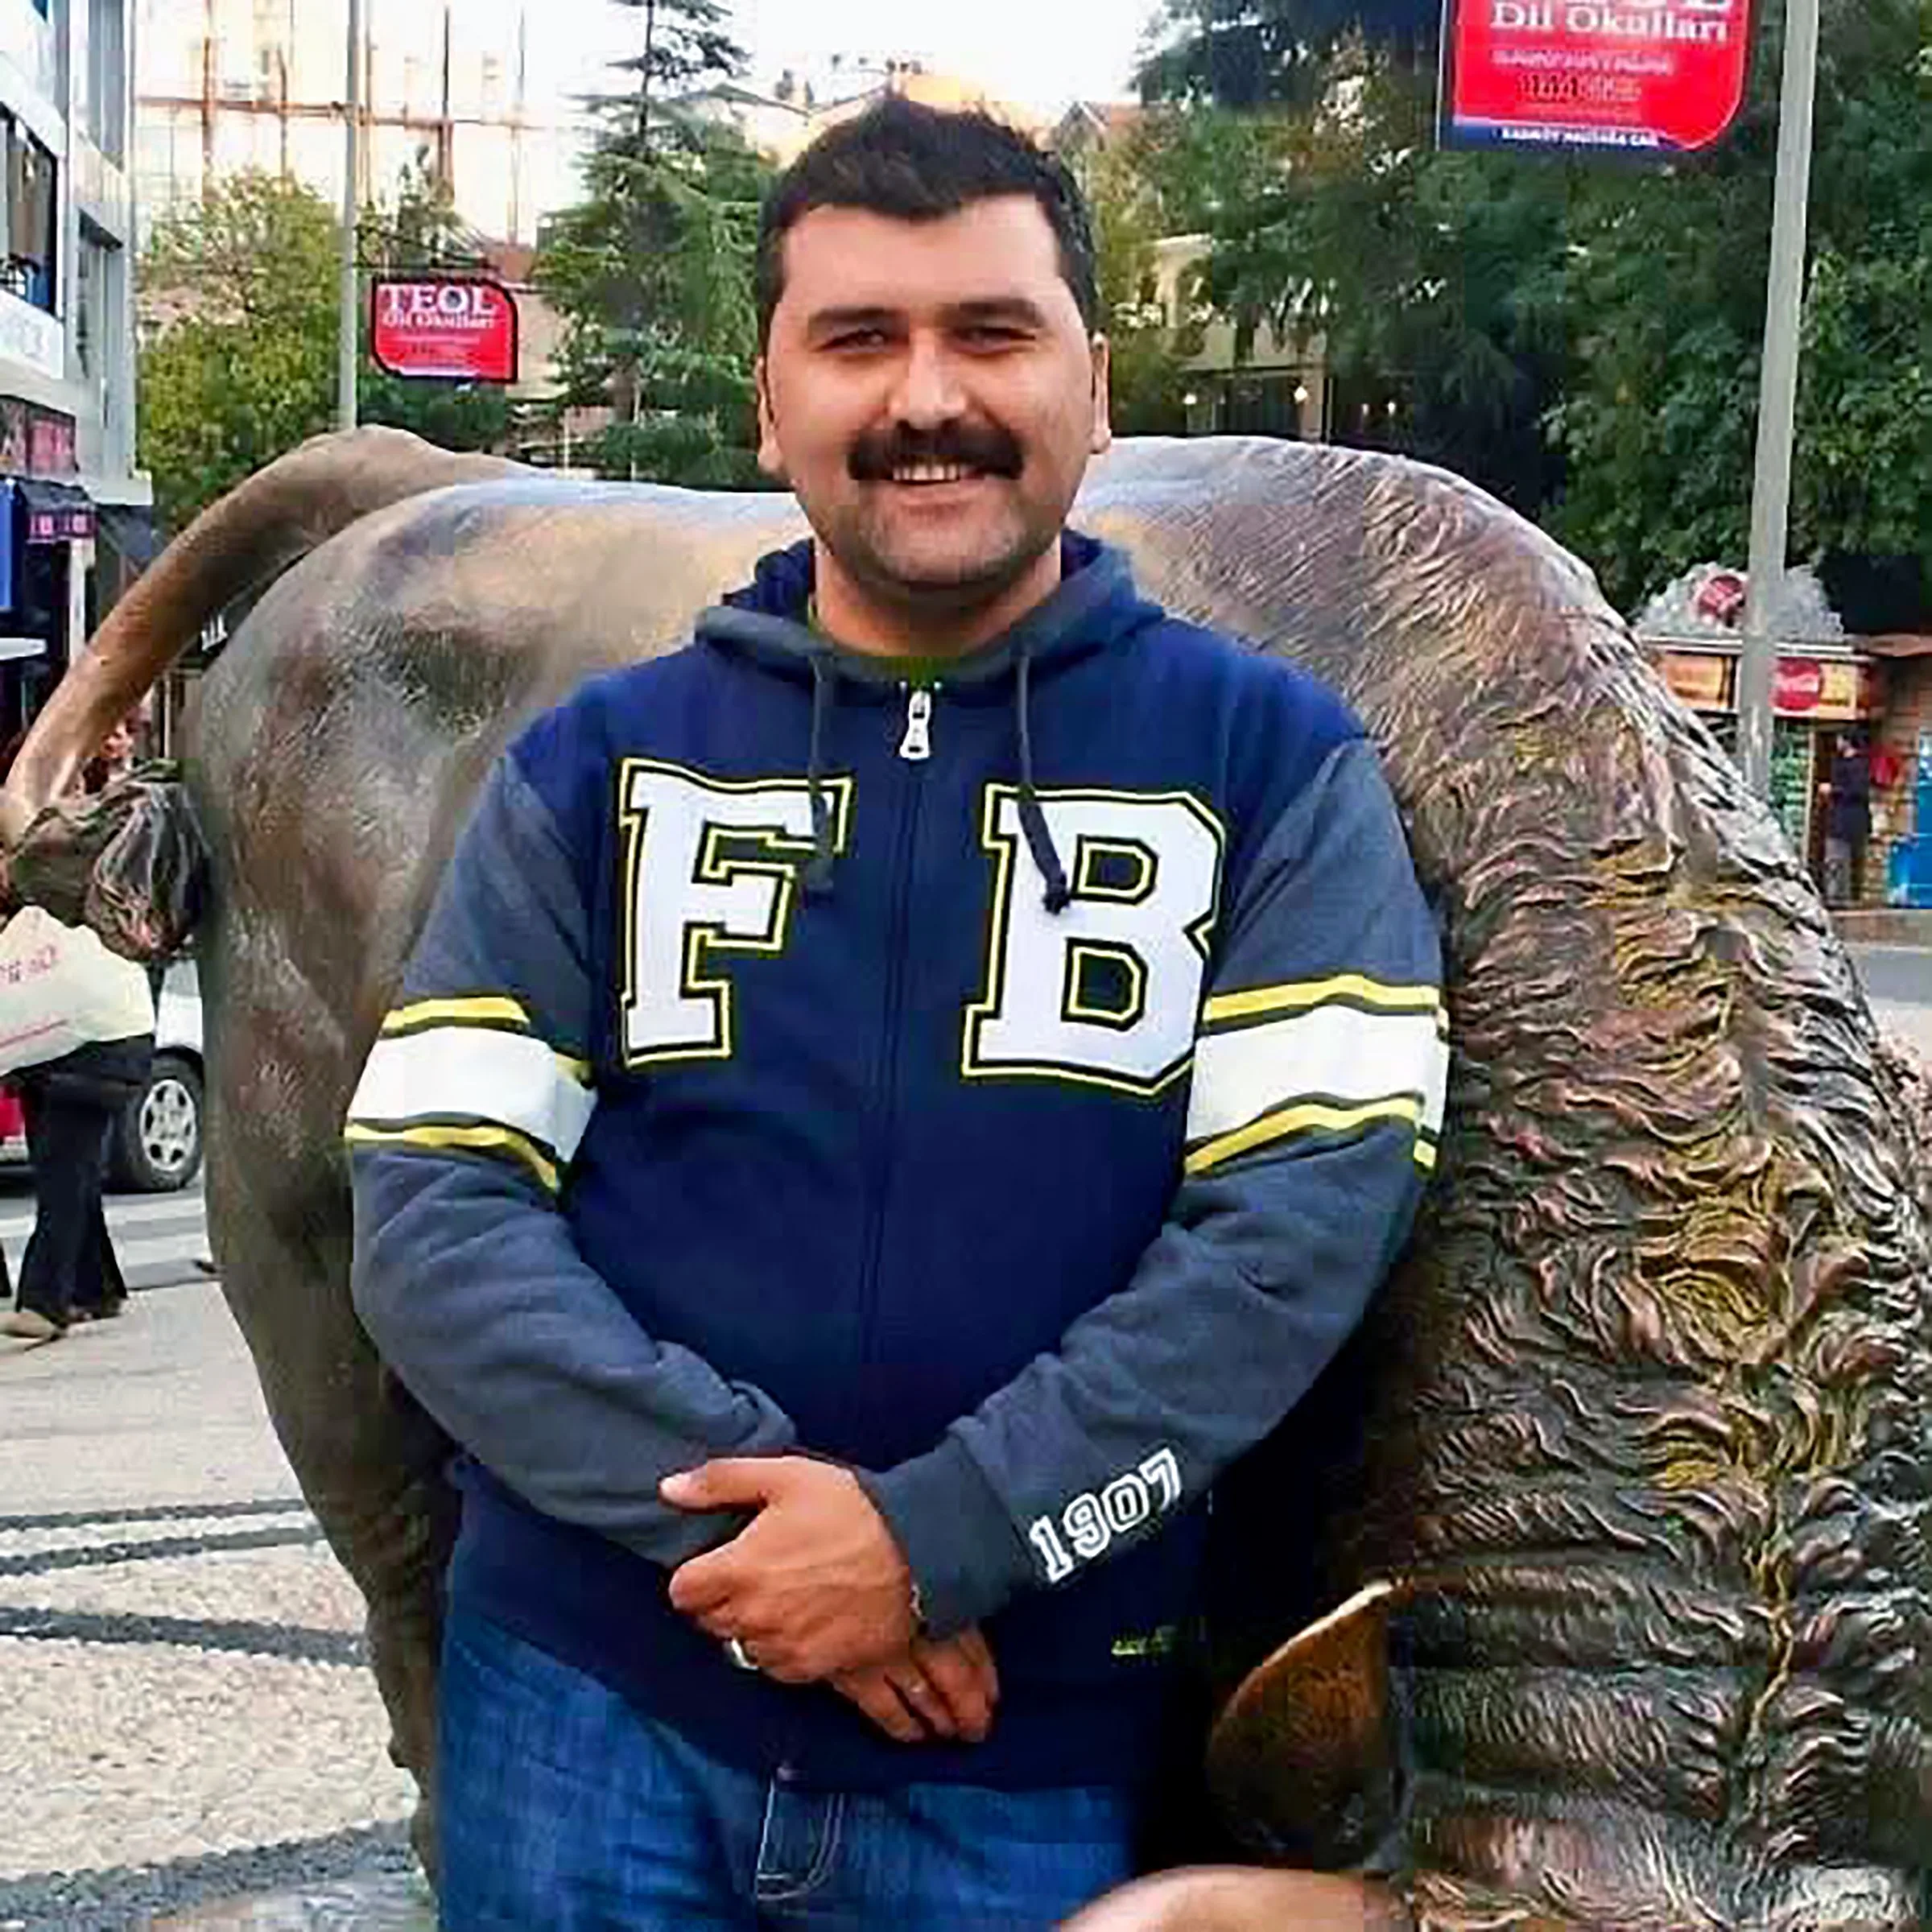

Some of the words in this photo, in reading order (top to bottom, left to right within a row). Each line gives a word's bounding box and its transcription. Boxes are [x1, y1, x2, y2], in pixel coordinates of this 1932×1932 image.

[1489, 1, 1554, 31] Dil
[620, 758, 853, 1068] F
[962, 784, 1226, 1094] B
[1029, 1447, 1182, 1583] 1907
